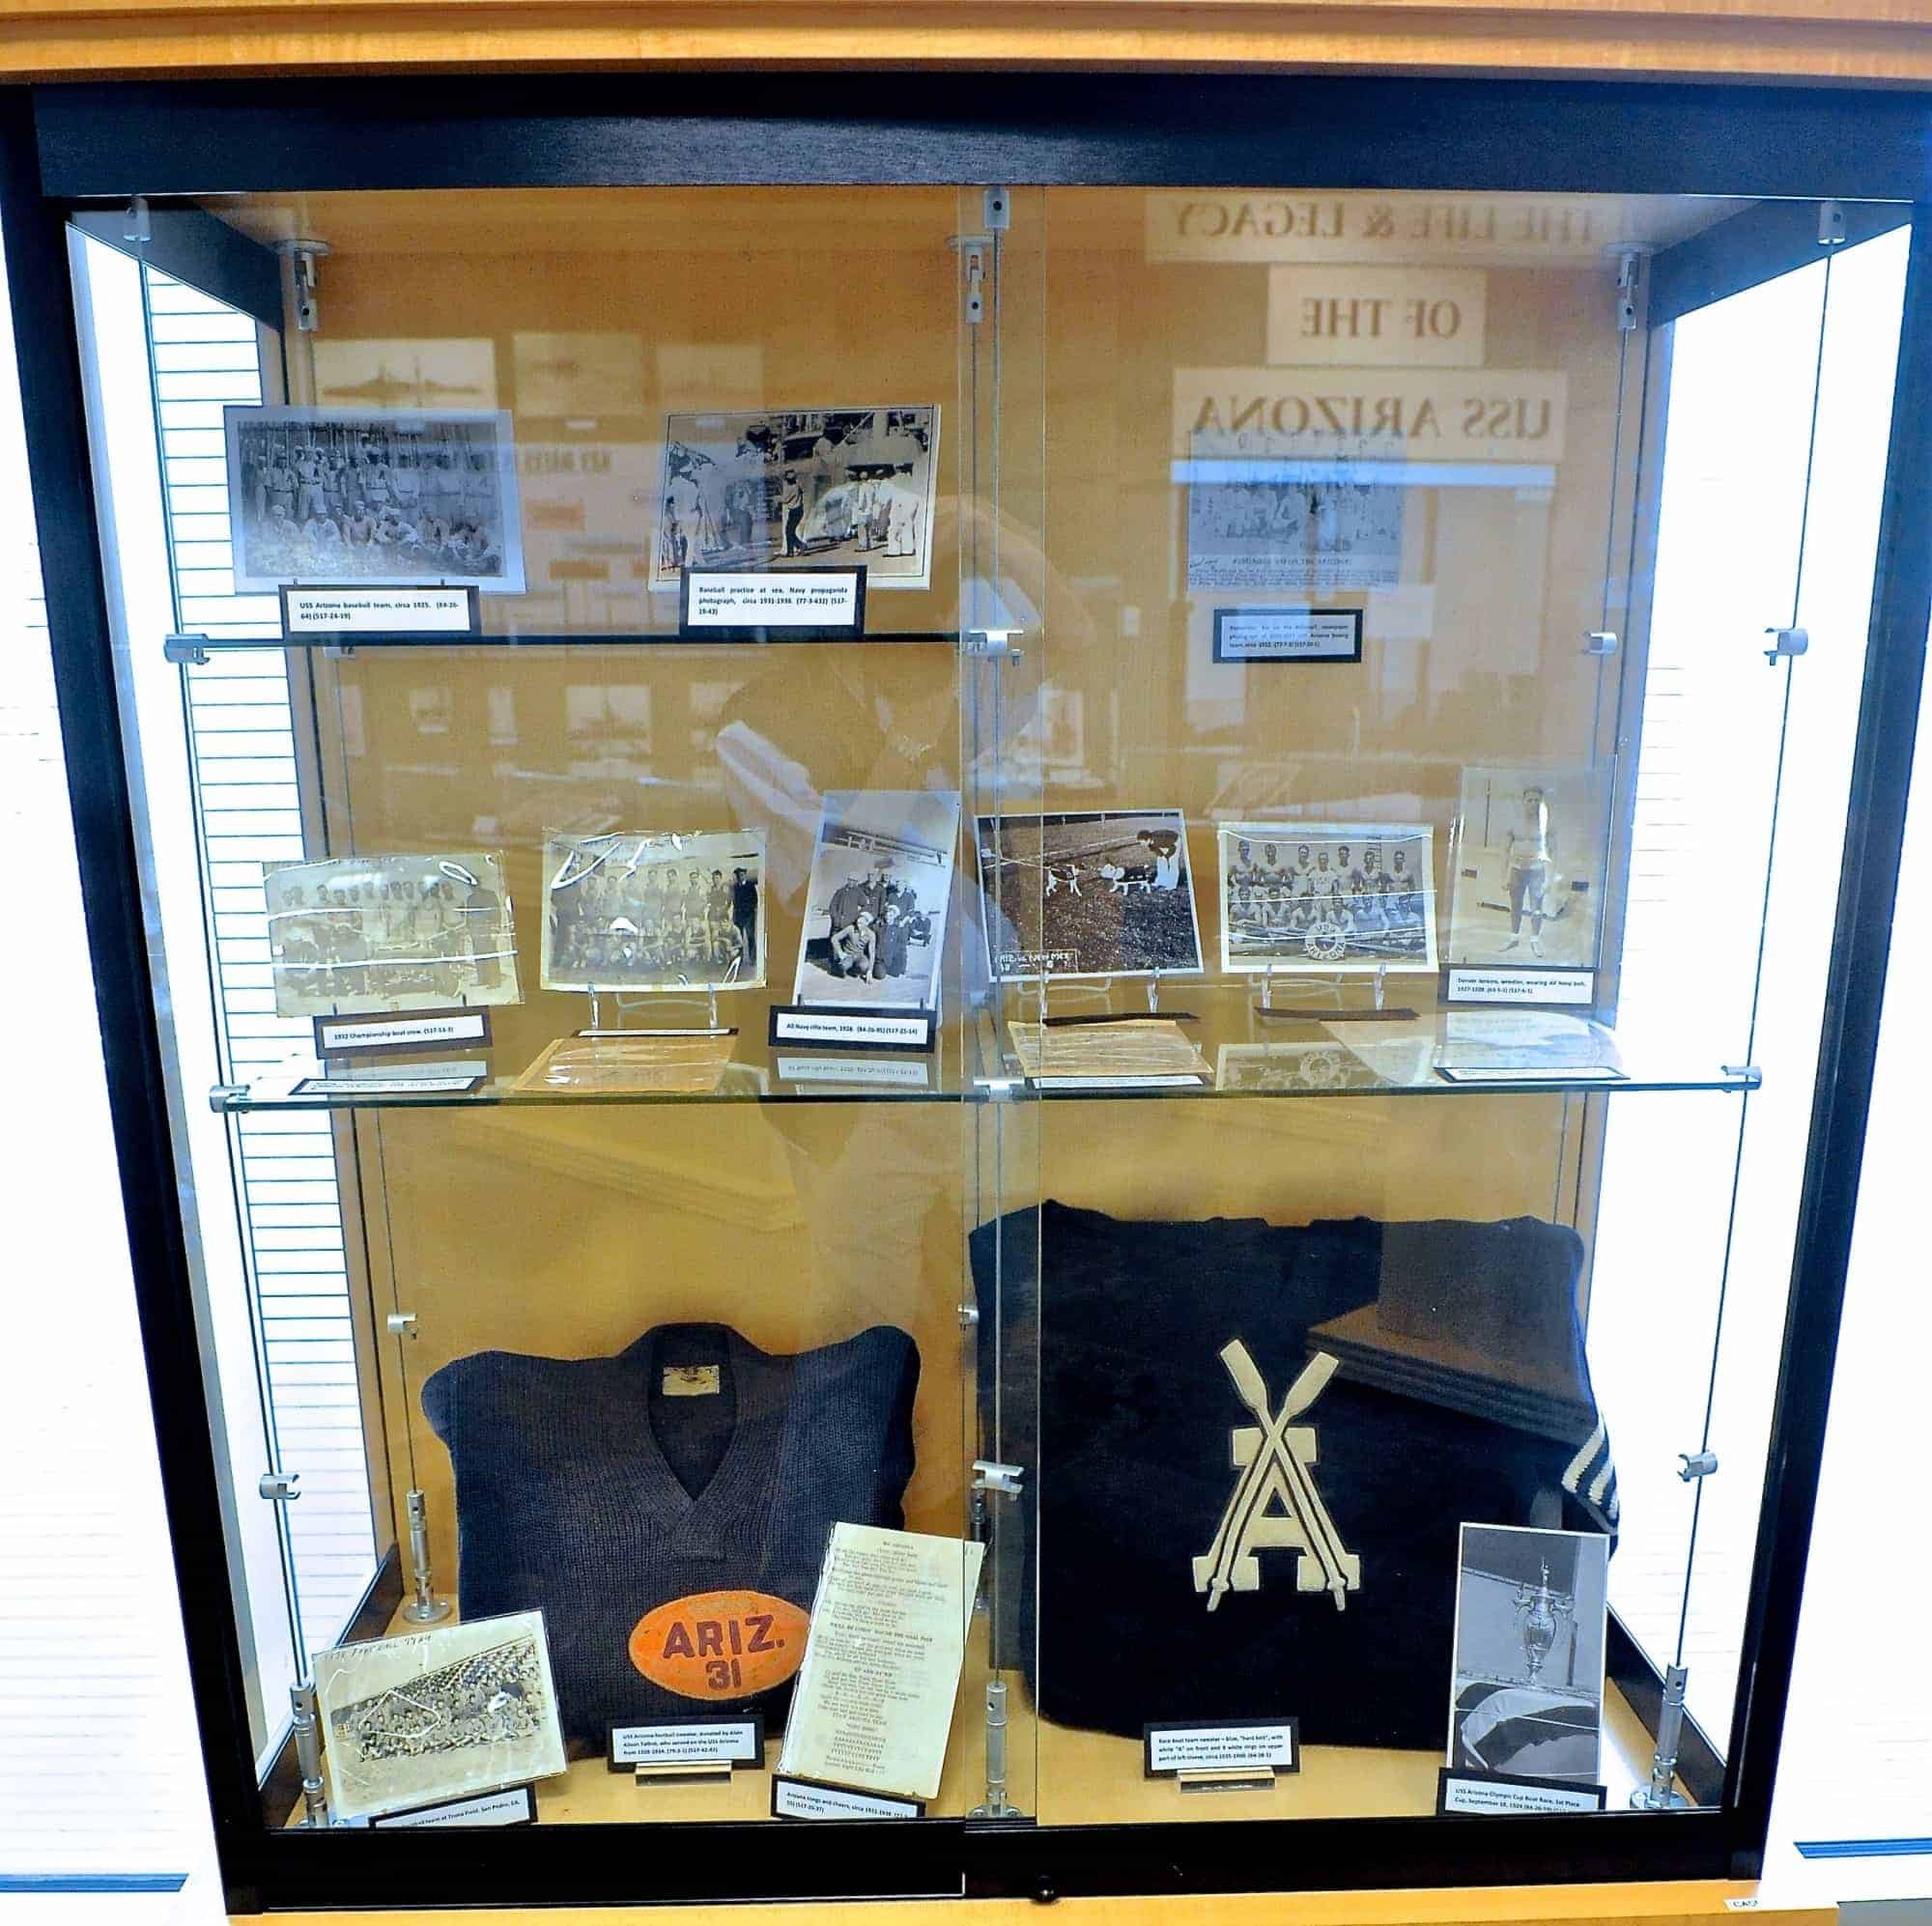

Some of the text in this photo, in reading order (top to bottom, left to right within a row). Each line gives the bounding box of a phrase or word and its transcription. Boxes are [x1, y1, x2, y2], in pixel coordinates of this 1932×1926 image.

[729, 586, 754, 595] practice
[789, 586, 806, 595] Navy
[810, 586, 848, 595] propaganda
[350, 1030, 390, 1039] Championship
[663, 1614, 785, 1658] ARIZ.
[705, 1659, 742, 1690] 31
[786, 1792, 806, 1801] Arizona
[1468, 1798, 1498, 1807] September
[1565, 1799, 1580, 1808] Place
